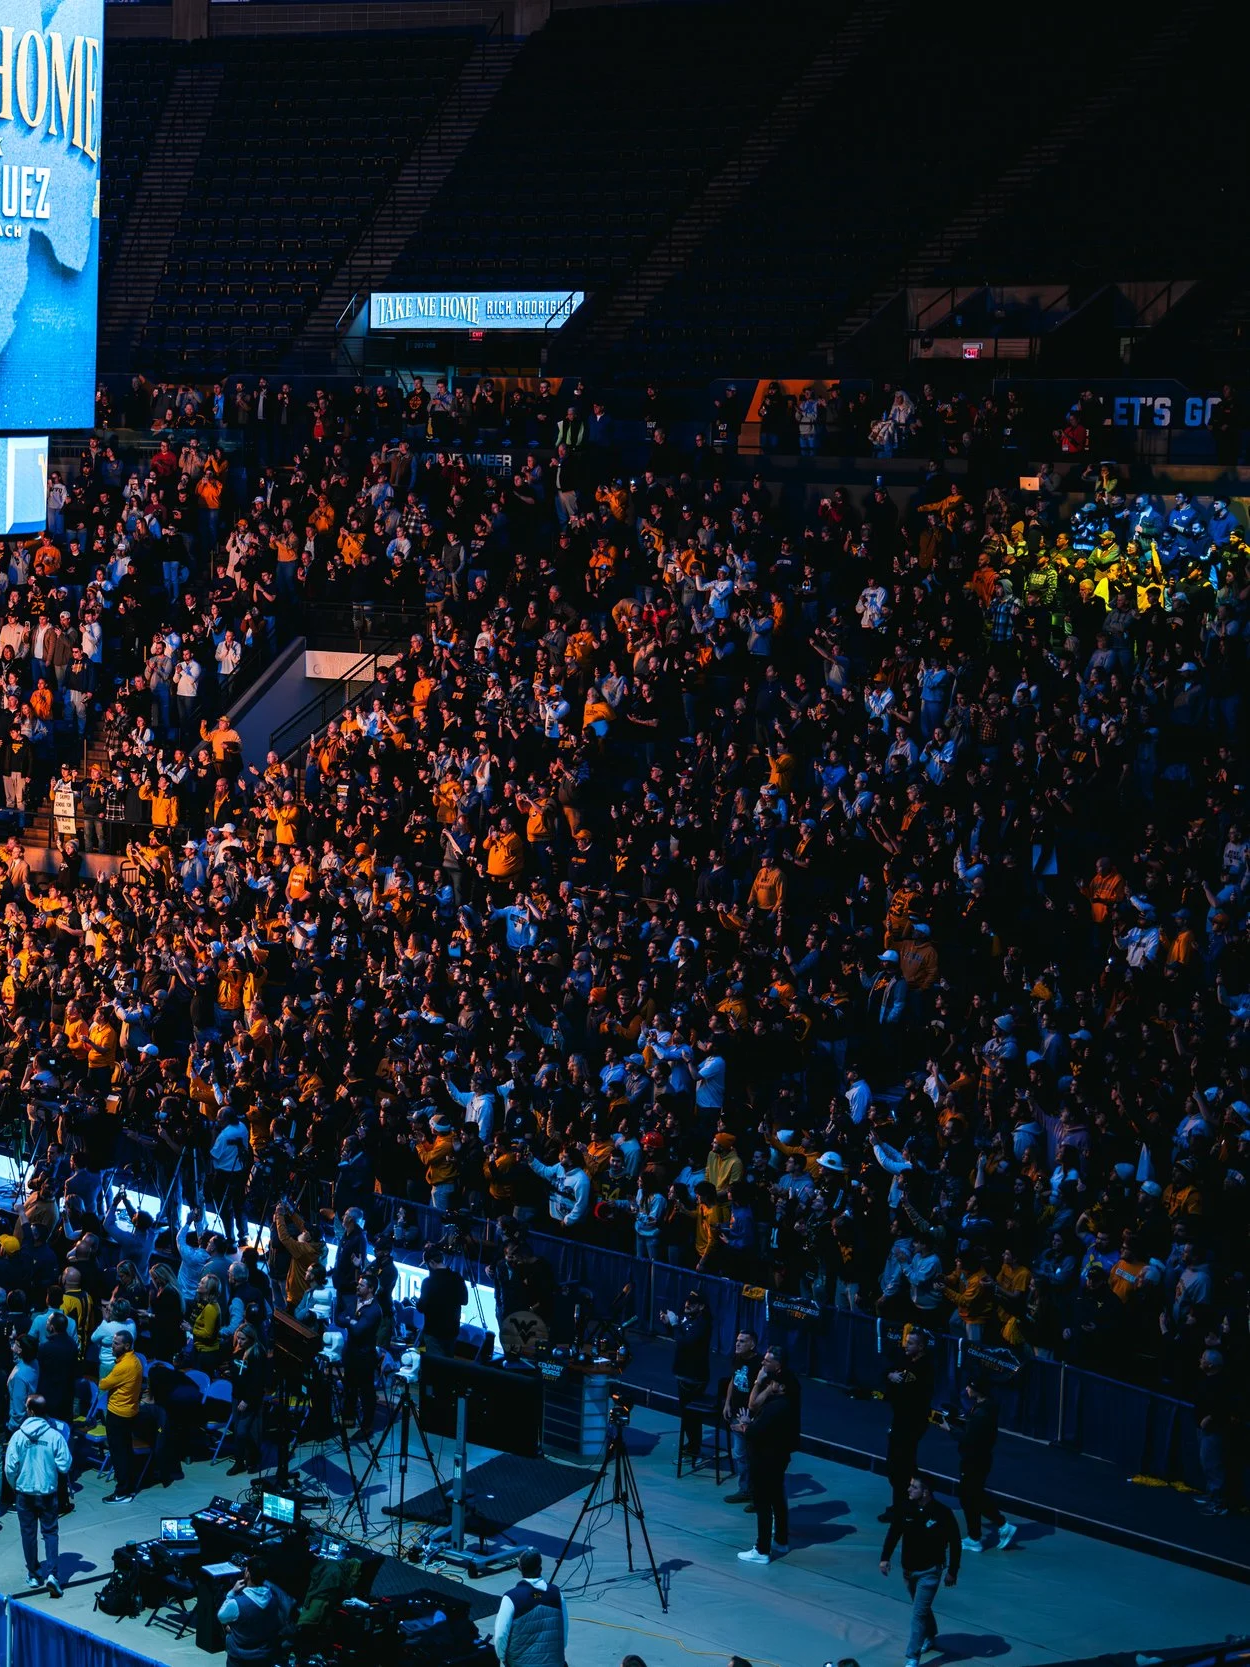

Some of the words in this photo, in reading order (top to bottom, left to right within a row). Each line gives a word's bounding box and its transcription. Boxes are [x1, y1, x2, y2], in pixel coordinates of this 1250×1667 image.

[379, 296, 413, 325] TAKE
[416, 296, 436, 317] ME
[440, 296, 480, 325] HOME
[486, 300, 512, 315] RICH
[1099, 396, 1171, 427] ET'S
